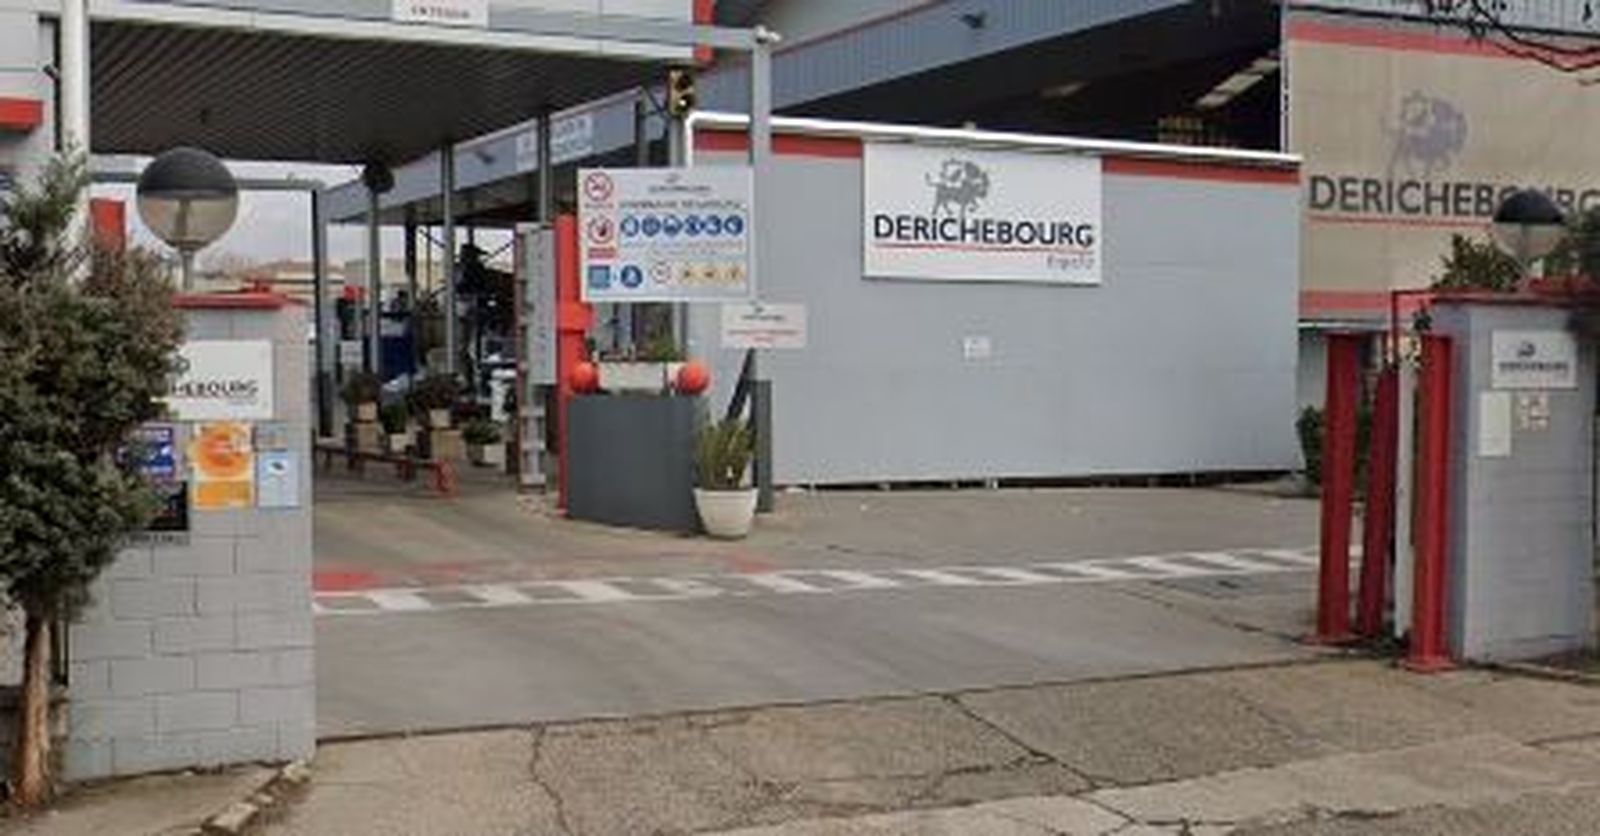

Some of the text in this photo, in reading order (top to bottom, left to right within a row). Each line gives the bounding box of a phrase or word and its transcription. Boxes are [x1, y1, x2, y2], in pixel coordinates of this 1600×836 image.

[1309, 175, 1600, 216] DERICHEBR
[873, 214, 1095, 247] DERICHEBOURG
[171, 379, 259, 399] HEBOURG
